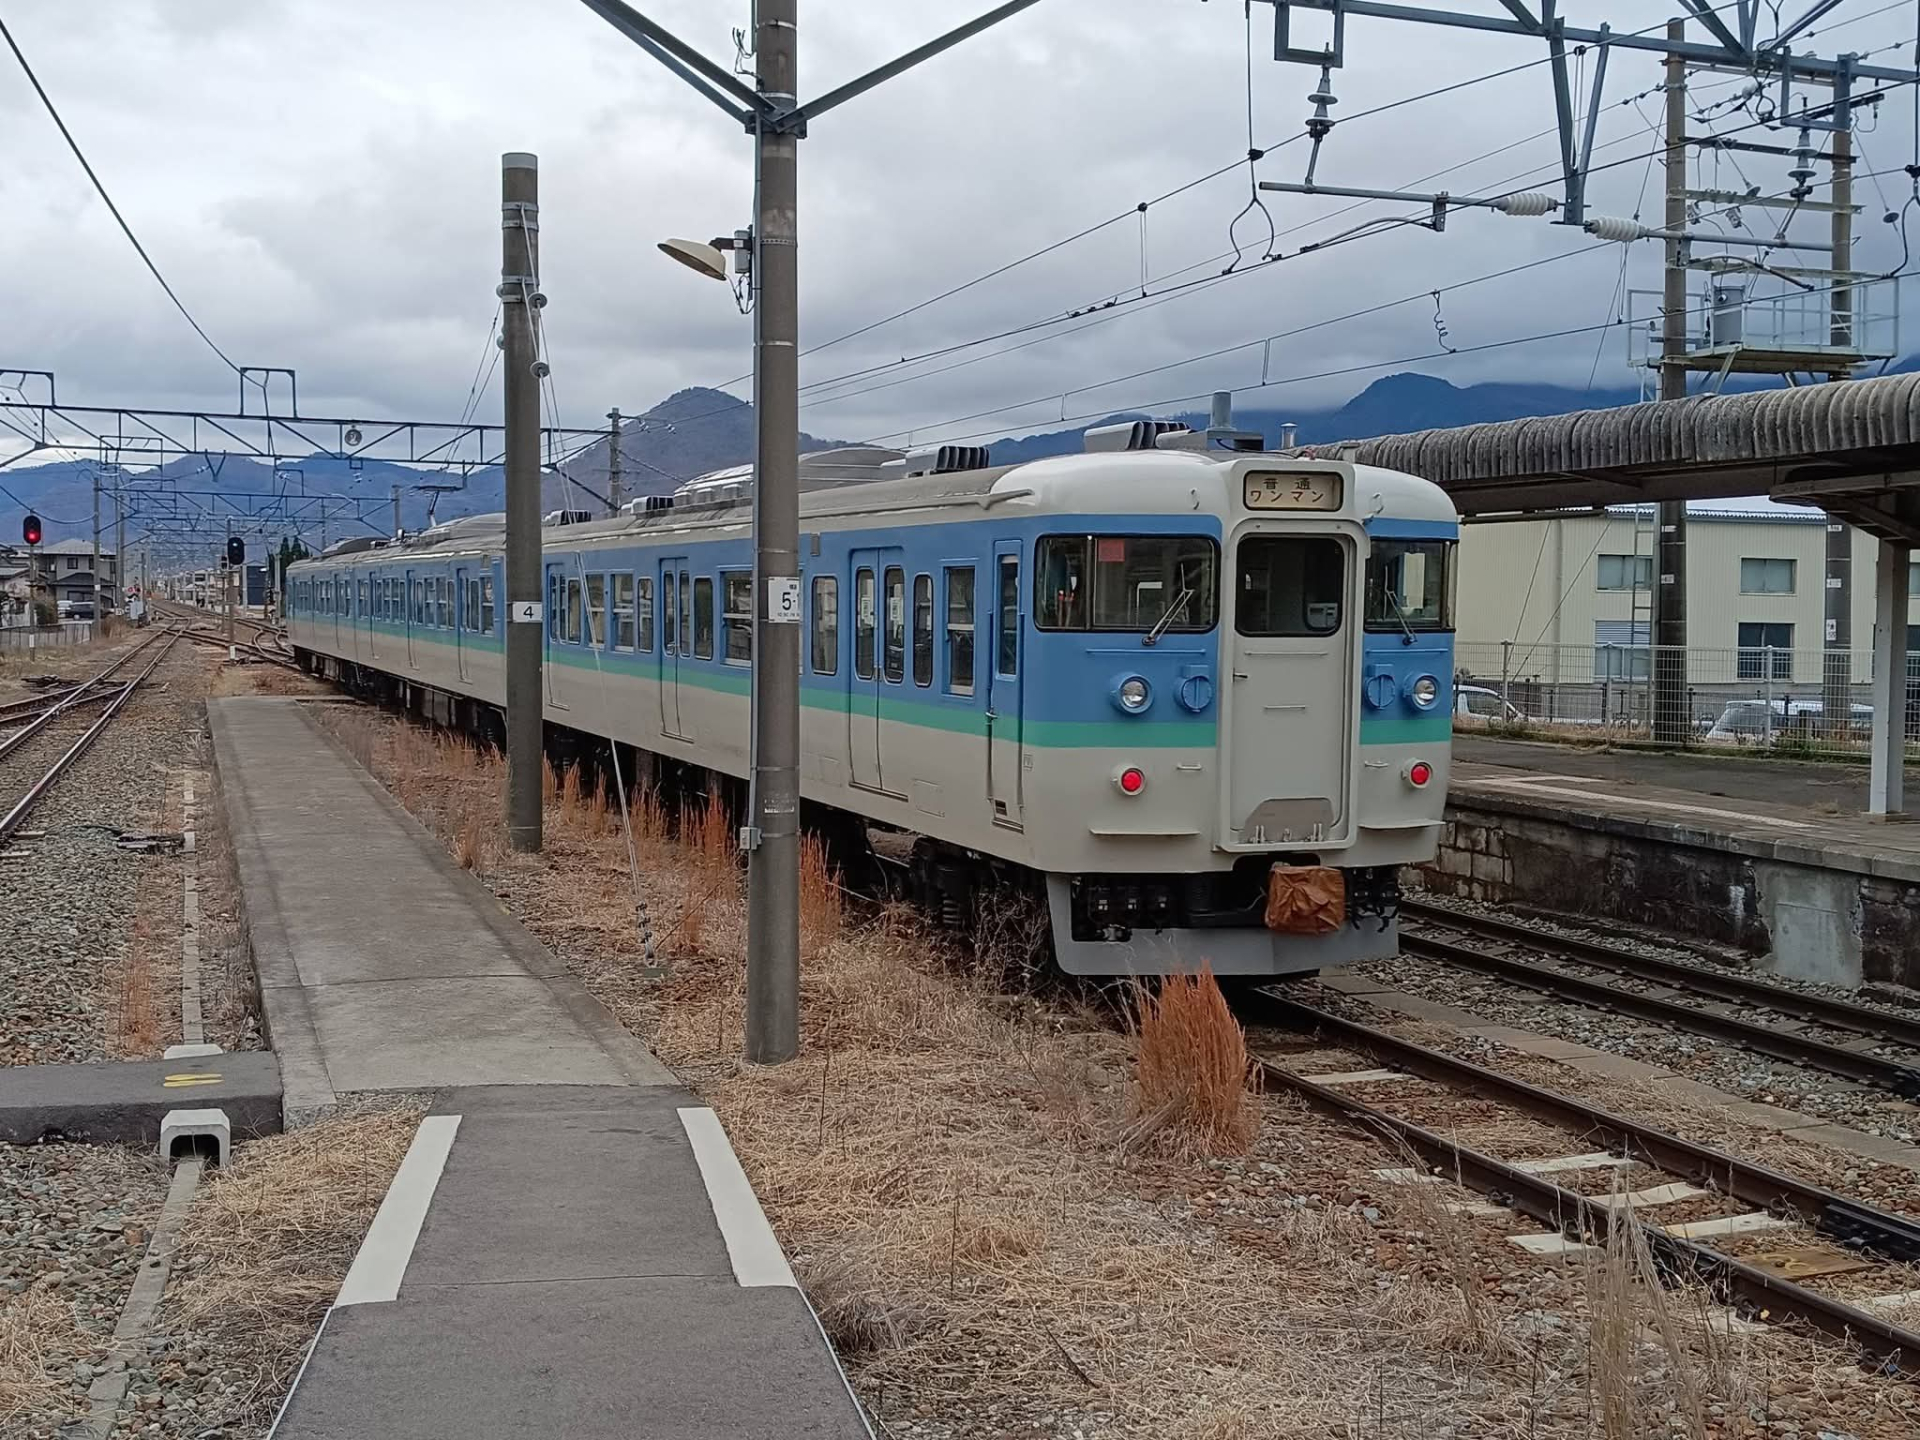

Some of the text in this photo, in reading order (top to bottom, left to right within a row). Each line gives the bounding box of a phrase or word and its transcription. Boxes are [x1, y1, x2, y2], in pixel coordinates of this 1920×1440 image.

[1263, 478, 1311, 490] 普通
[1250, 490, 1324, 502] ワンマン
[523, 605, 534, 619] 4
